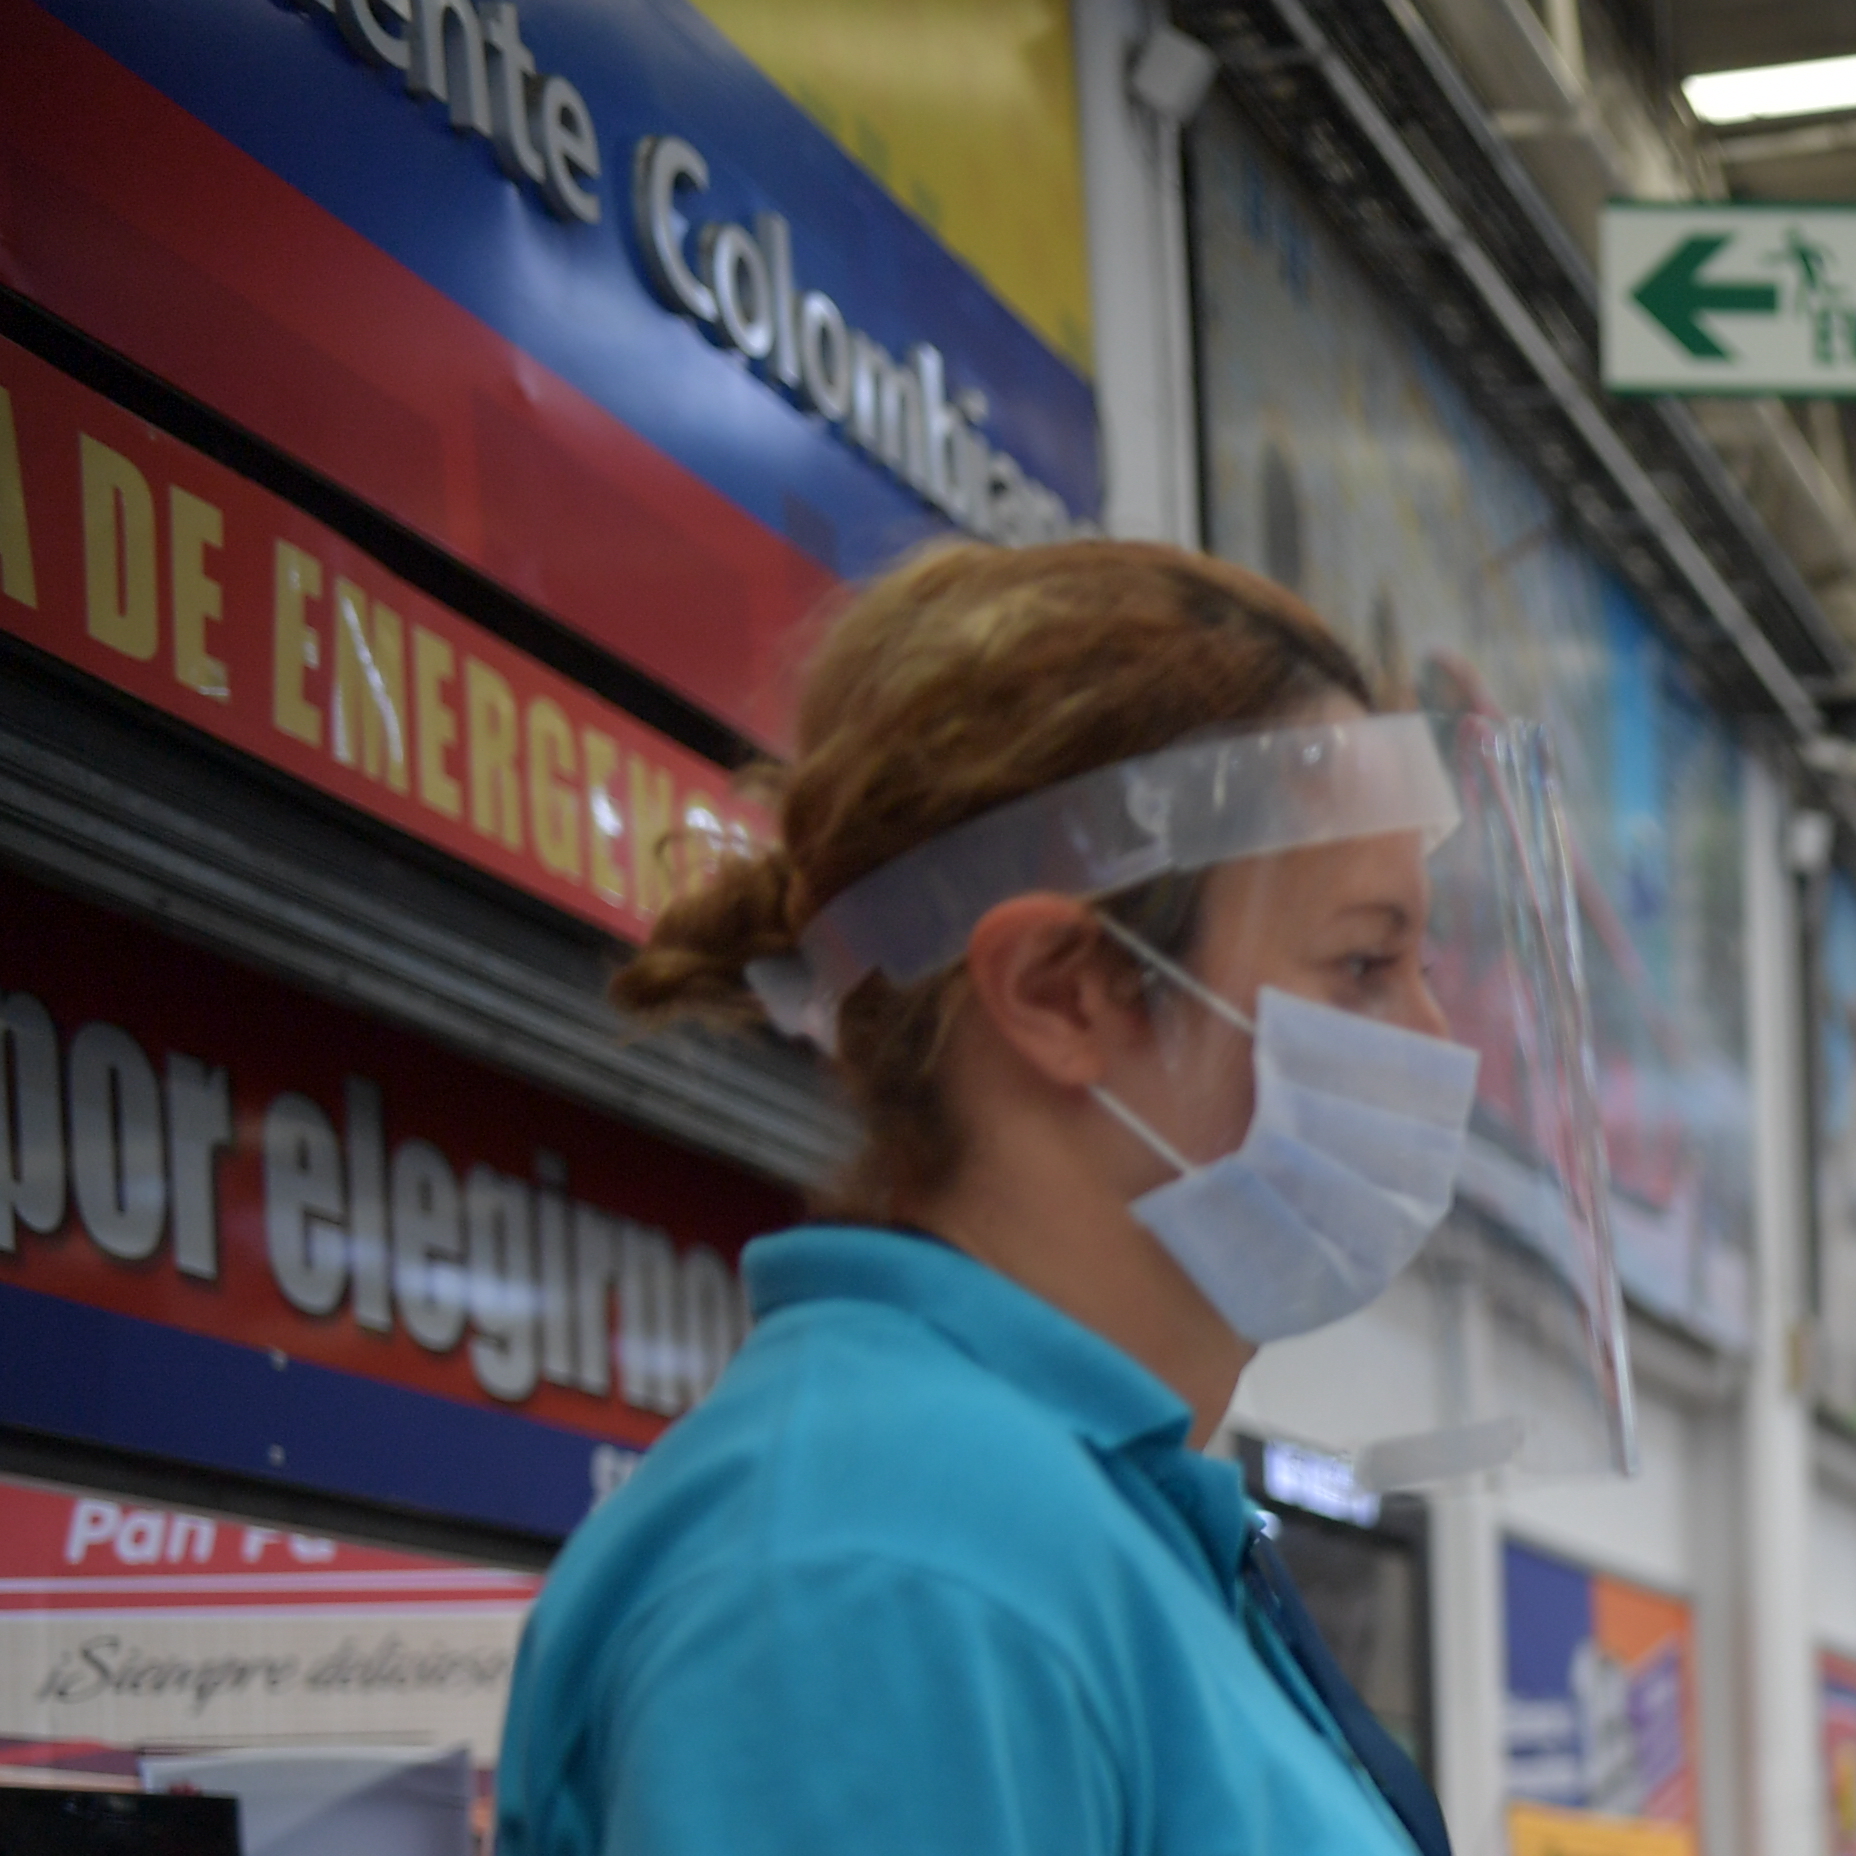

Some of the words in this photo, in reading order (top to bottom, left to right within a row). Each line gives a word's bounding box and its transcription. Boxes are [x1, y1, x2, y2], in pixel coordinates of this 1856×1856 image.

[78, 432, 231, 706] DE
[0, 990, 233, 1282] por
[262, 1070, 752, 1418] elegirno
